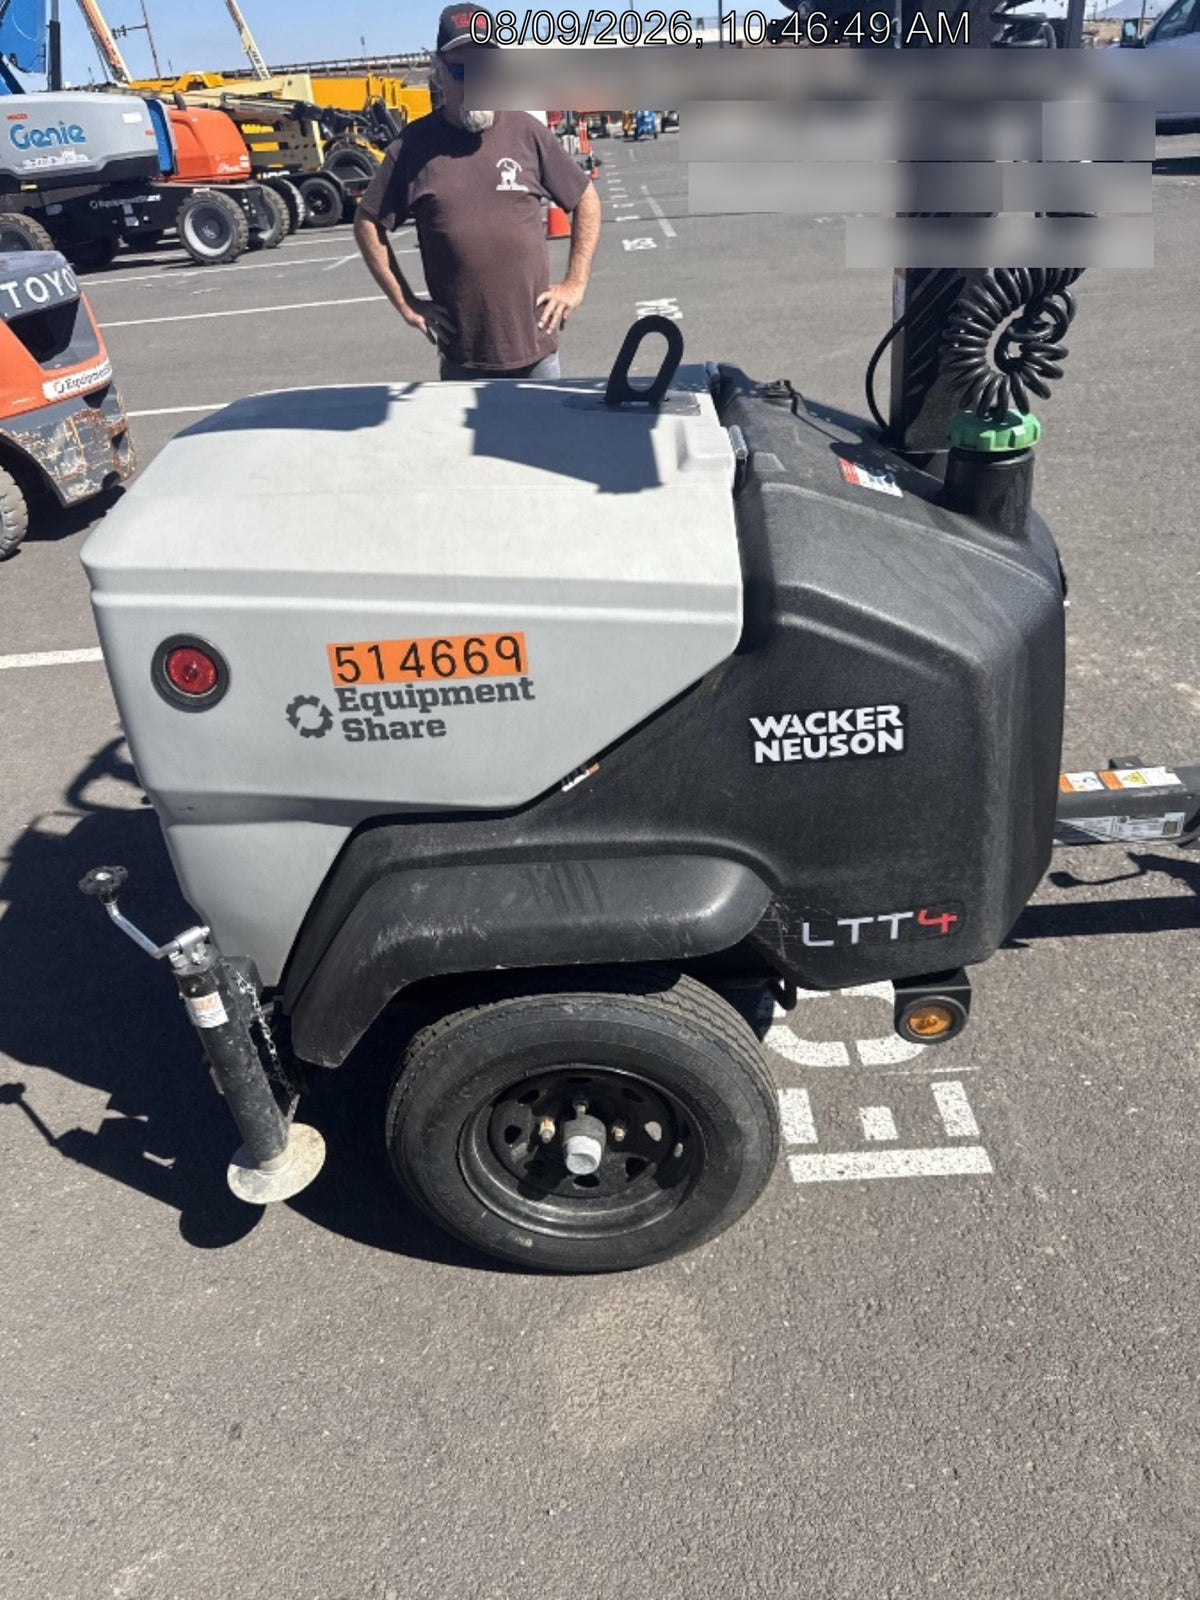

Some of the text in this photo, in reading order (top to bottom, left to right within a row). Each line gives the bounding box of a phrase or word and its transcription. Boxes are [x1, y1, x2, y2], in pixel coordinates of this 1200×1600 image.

[9, 120, 87, 150] Genie
[335, 636, 523, 683] 514669
[335, 677, 536, 715] Equipment
[341, 718, 447, 742] Share
[749, 704, 904, 739] WACKER
[754, 728, 904, 764] NEUSON
[802, 909, 958, 947] LTT4
